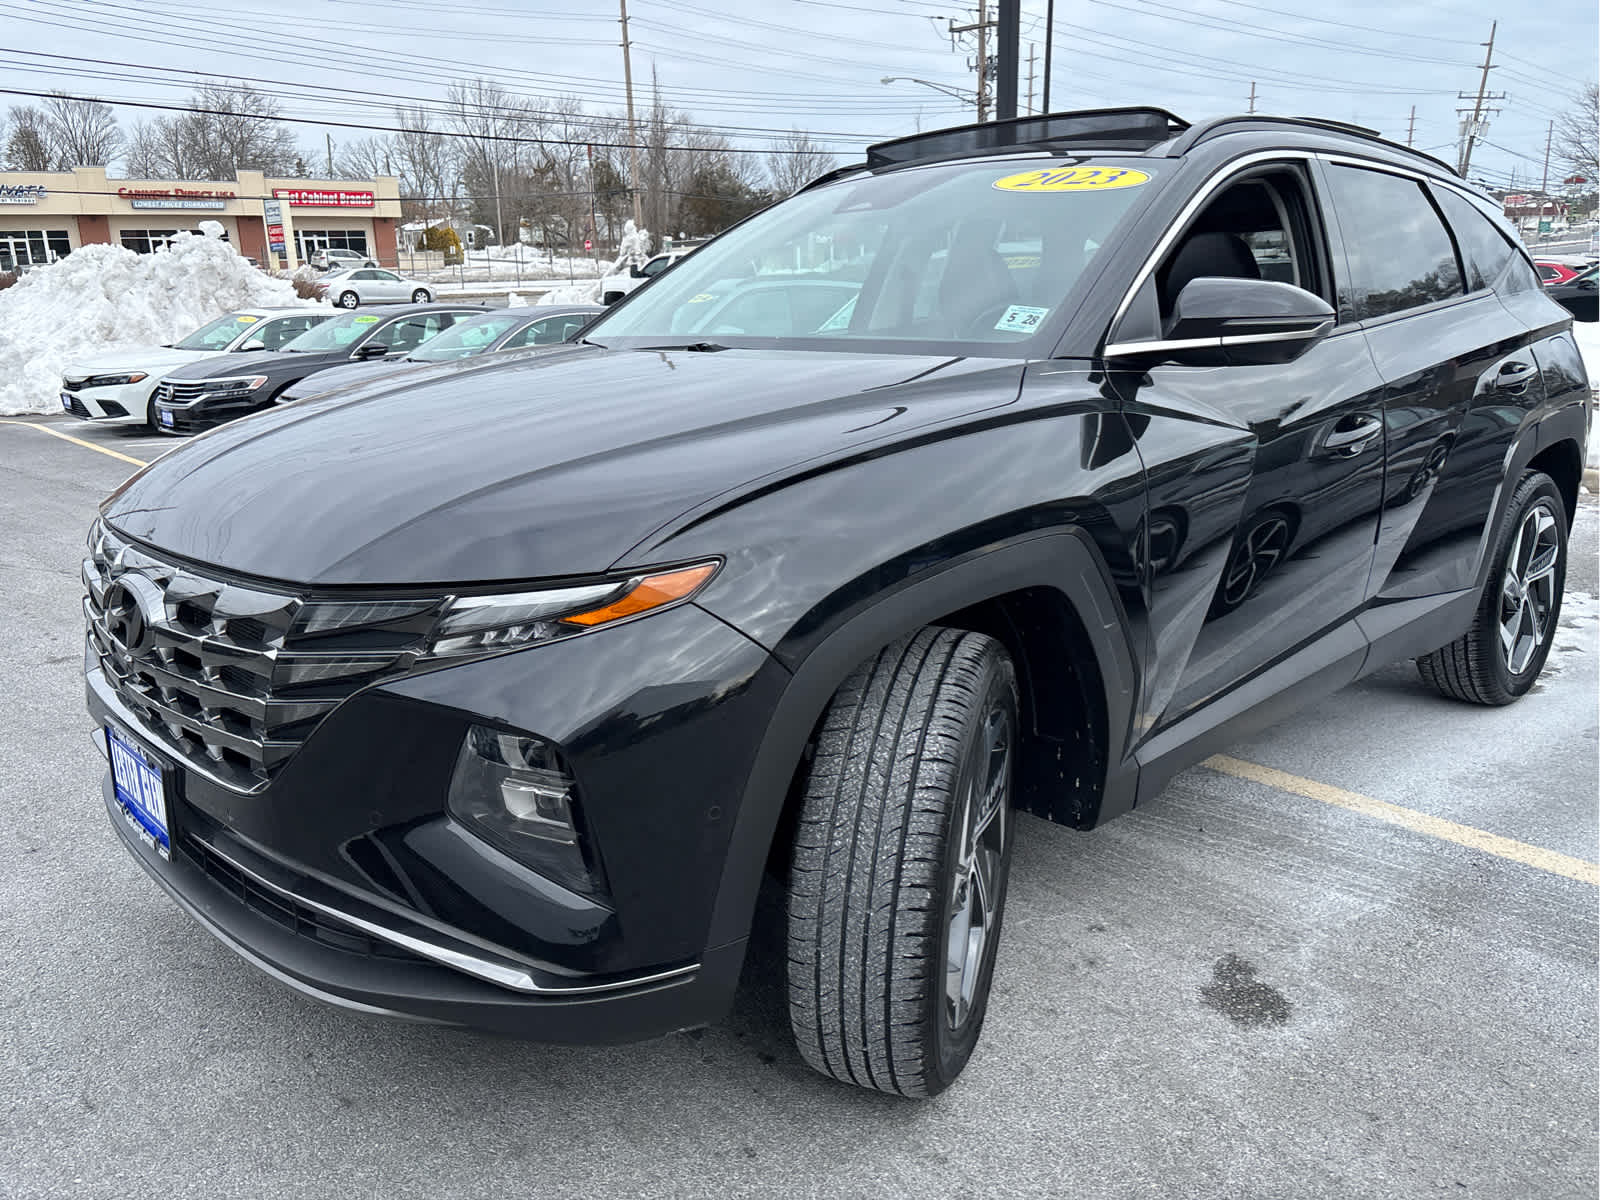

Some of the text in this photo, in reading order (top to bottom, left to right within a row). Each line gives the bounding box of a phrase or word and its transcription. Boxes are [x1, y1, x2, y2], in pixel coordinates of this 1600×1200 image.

[1014, 170, 1128, 187] 2023
[134, 199, 159, 208] LOWEST
[301, 191, 338, 204] Cabinet
[339, 193, 372, 205] Brands
[1007, 312, 1040, 326] 5 28
